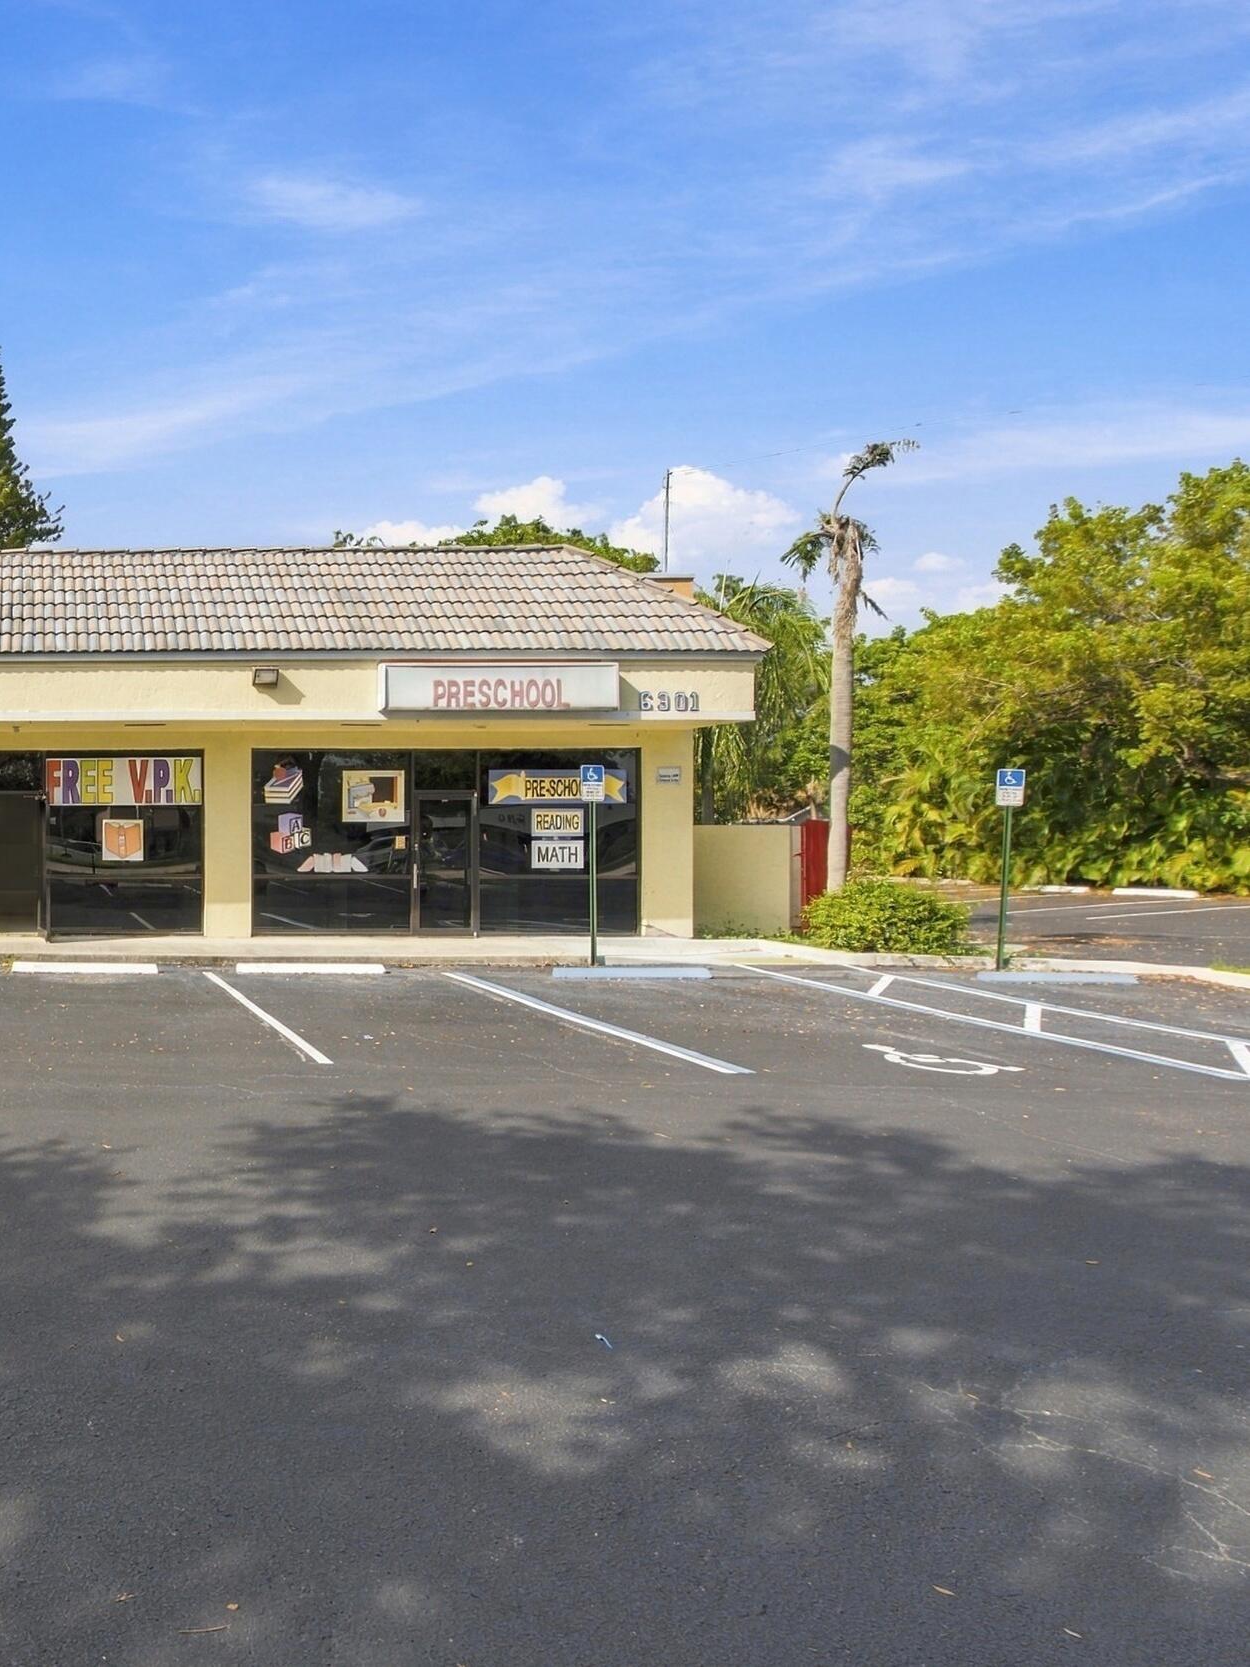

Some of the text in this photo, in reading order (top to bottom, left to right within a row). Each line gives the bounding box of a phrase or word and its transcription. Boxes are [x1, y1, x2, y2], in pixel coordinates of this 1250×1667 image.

[433, 679, 570, 709] PRESCHOOL
[639, 691, 699, 711] 6301
[47, 759, 200, 804] FREE V.P.K.
[525, 779, 581, 798] PRE-SCHO
[291, 819, 301, 832] A
[536, 814, 579, 831] READING
[285, 832, 310, 850] B C
[537, 846, 578, 863] MATH
